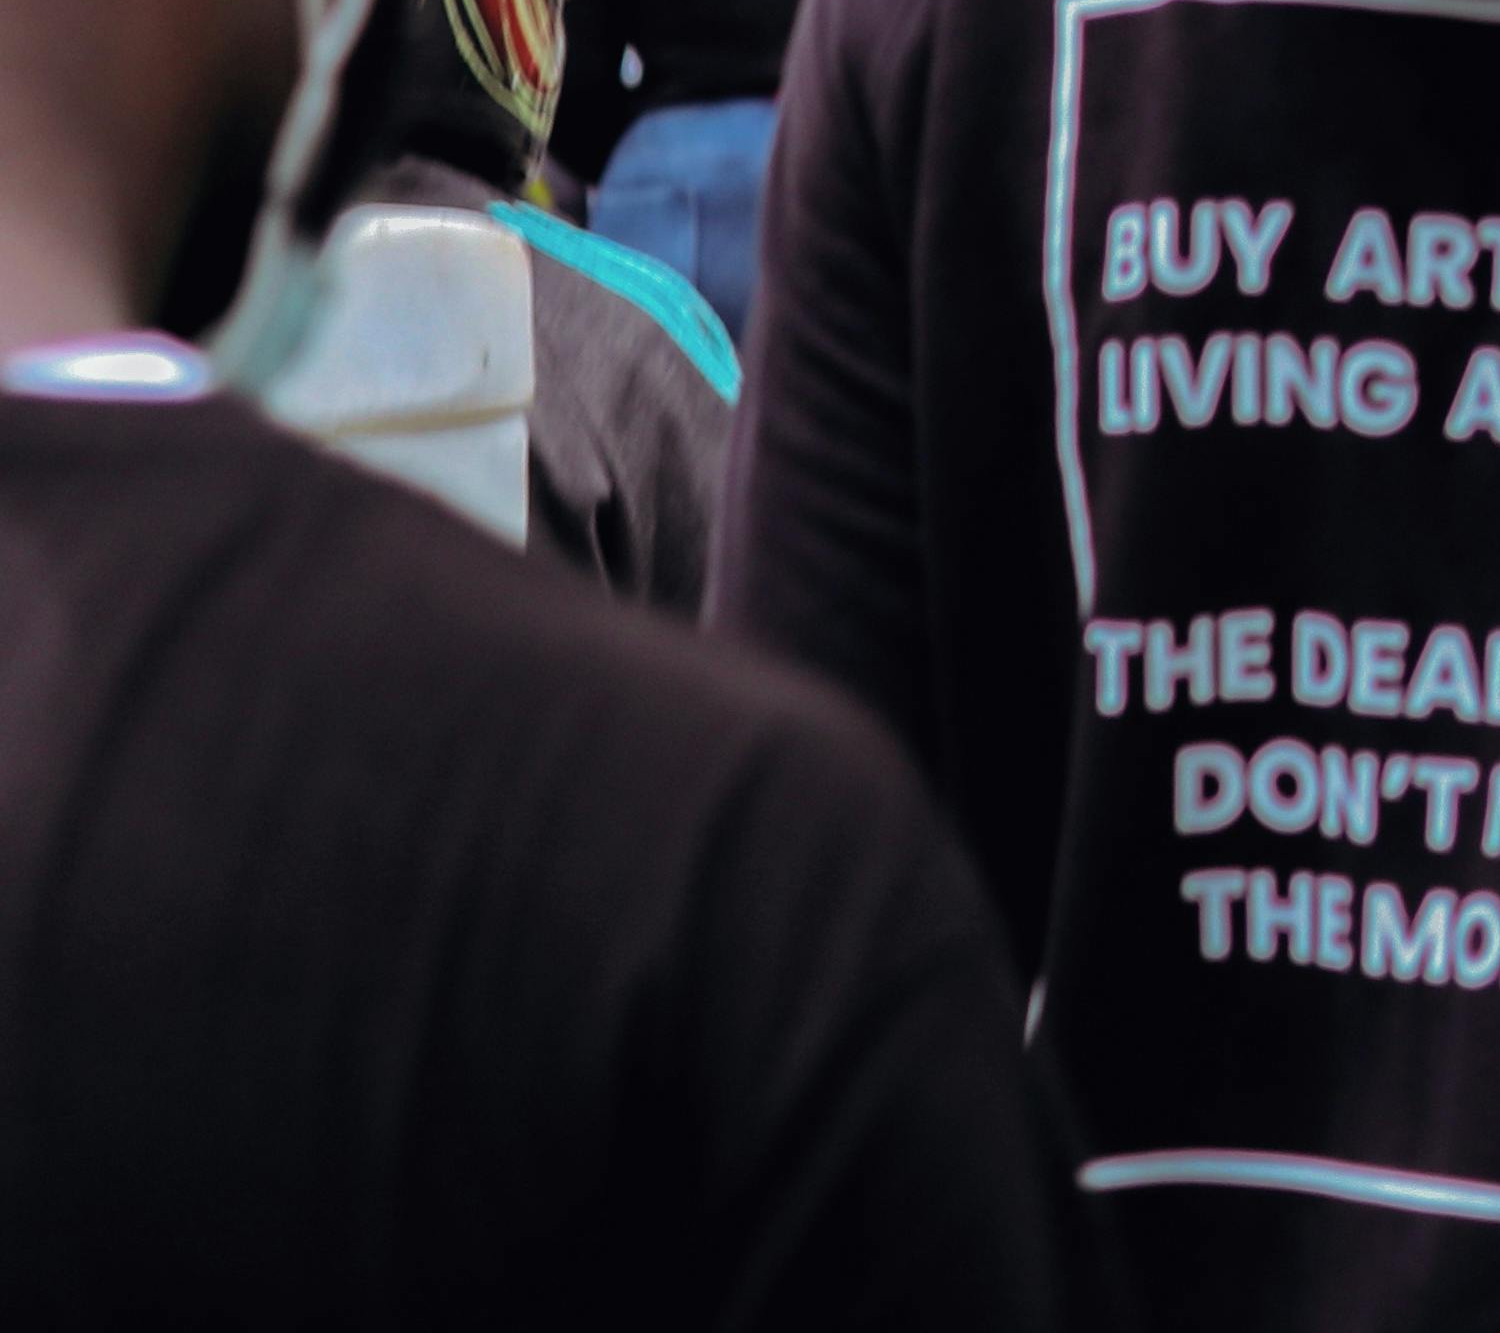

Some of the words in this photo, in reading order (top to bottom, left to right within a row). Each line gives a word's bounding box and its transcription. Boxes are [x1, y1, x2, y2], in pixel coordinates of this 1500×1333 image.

[1100, 197, 1294, 304] BUY
[1097, 332, 1419, 437] LIVING
[1082, 608, 1276, 717] THE
[1173, 738, 1481, 852] DON'T
[1181, 868, 1354, 972] THE
